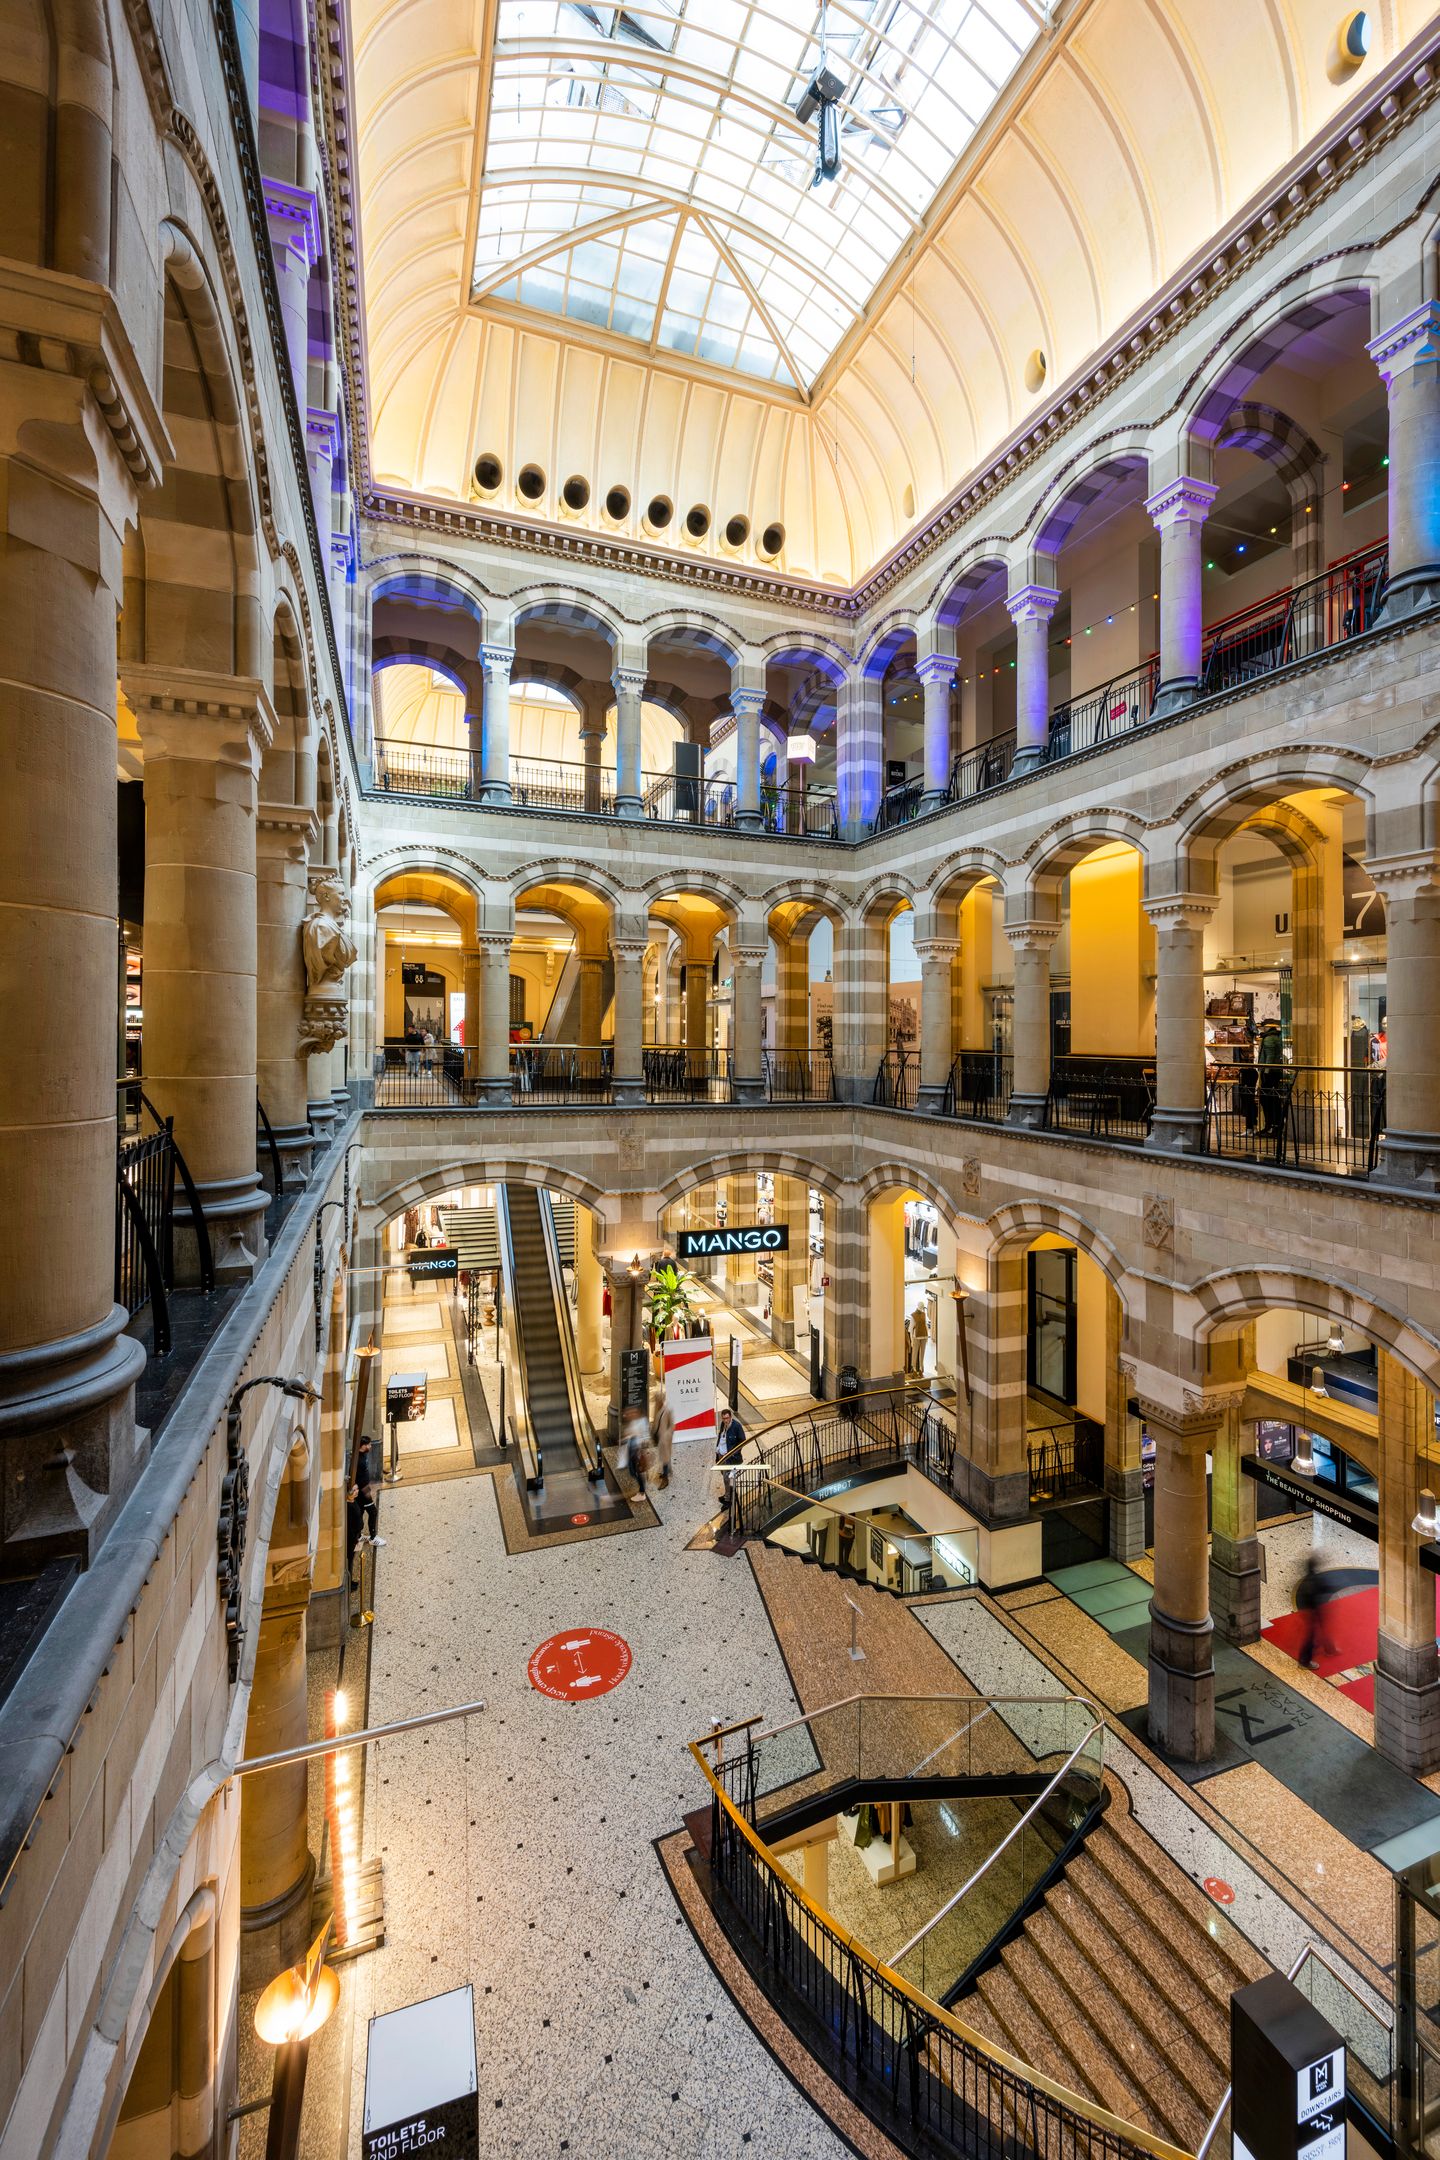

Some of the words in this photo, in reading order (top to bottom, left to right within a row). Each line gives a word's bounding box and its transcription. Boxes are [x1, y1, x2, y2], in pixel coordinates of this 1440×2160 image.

[688, 1230, 781, 1253] MANGO
[677, 1378, 701, 1386] FINAL
[680, 1387, 700, 1395] SALE
[819, 1479, 852, 1500] HUTSPOT
[1266, 1474, 1279, 1486] THE
[1279, 1481, 1305, 1499] BEAUTY
[1305, 1495, 1315, 1504] OF
[1315, 1500, 1352, 1523] SHOPPING
[545, 1686, 568, 1699] Keep
[1250, 1683, 1308, 1727] MAGNA
[1264, 1682, 1314, 1720] PLAZA
[1300, 2089, 1342, 2119] DOWNSTAIRS
[369, 2120, 426, 2152] TOILETS
[402, 2126, 446, 2154] FLOOR
